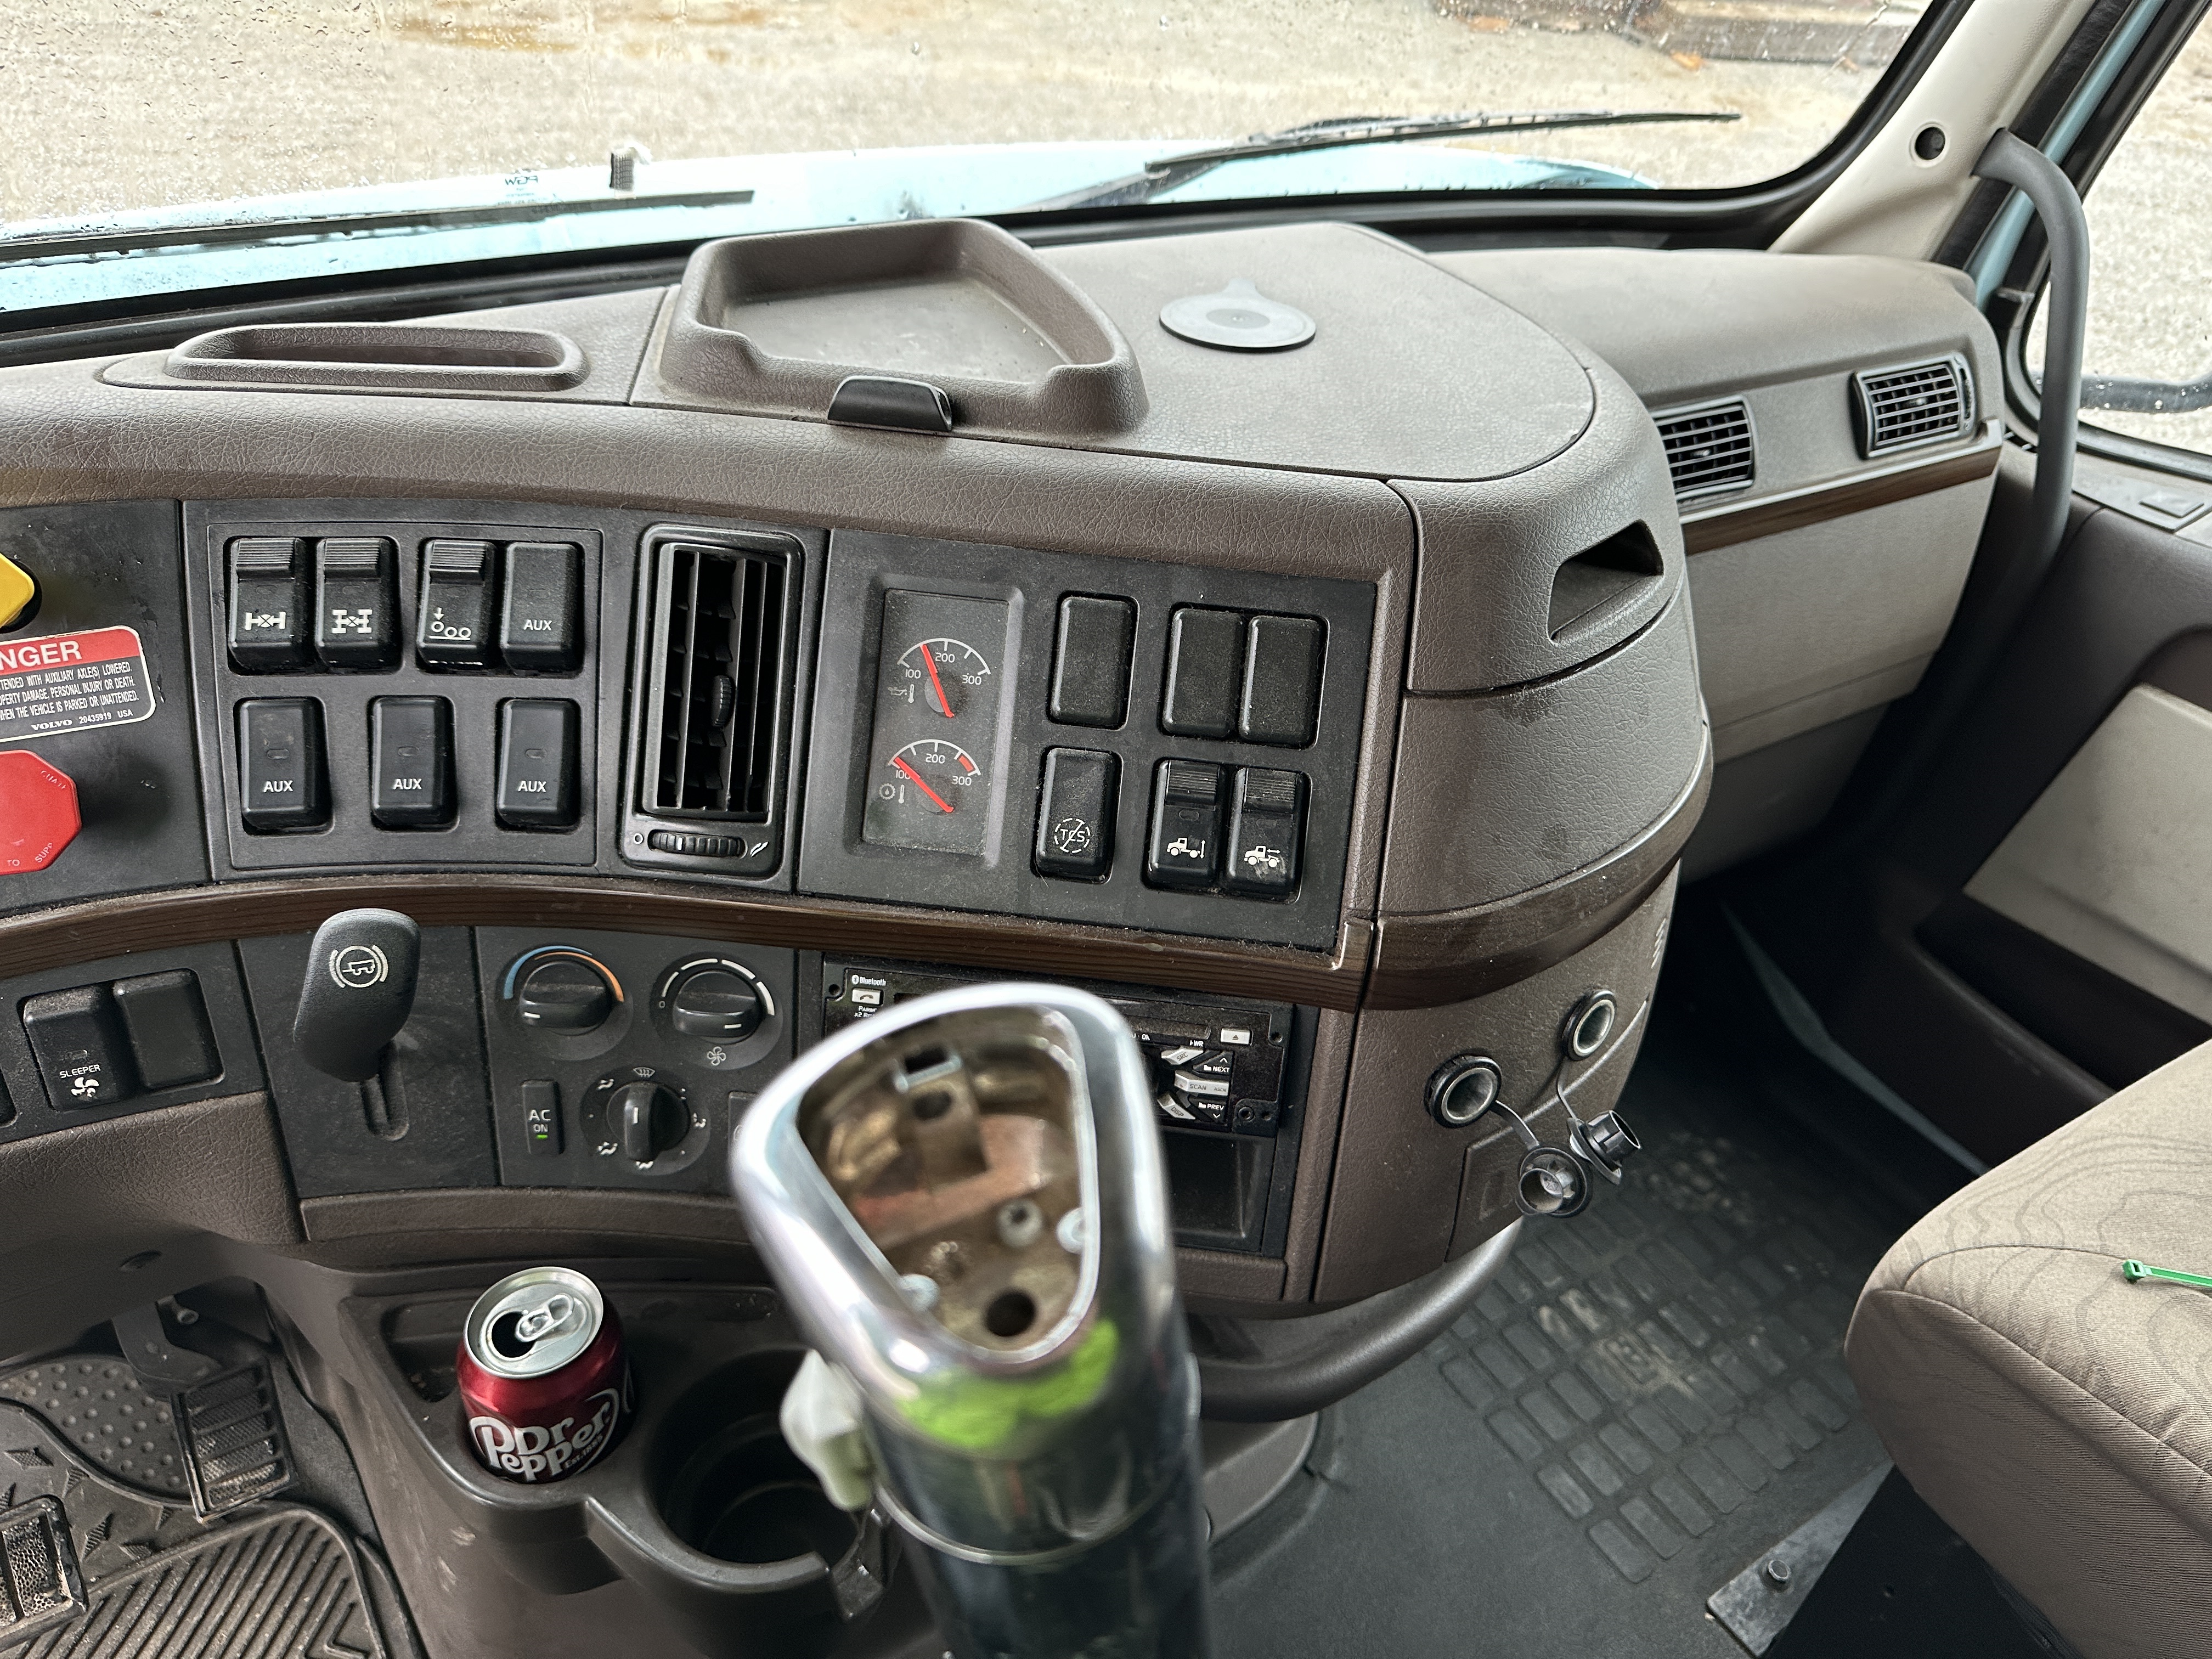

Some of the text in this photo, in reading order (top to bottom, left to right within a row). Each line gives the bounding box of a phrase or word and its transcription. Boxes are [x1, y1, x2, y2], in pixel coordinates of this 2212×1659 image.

[523, 619, 552, 631] AUX
[0, 640, 82, 670] NGER
[935, 652, 955, 663] 200
[0, 661, 133, 690] TENDED WITH AUXILIARY AXLE(S) LOWERED.
[905, 669, 921, 679] 100
[962, 674, 982, 686] 300
[21, 688, 50, 702] DAMAGE,
[49, 684, 82, 698] PERSONAL
[82, 680, 103, 693] INJURY
[104, 679, 115, 690] OR
[114, 675, 136, 689] DEATH.
[15, 706, 29, 718] THE
[29, 702, 55, 716] VEHICLE
[55, 701, 63, 712] IS
[64, 697, 88, 712] PARKED
[89, 696, 99, 707] OR
[99, 690, 139, 706] UNATTENDED.
[31, 709, 134, 731] VOLVO 20435919 USA
[926, 753, 946, 764] 200
[895, 769, 911, 780] 100
[952, 775, 972, 786] 300
[263, 780, 293, 793] AUX
[392, 778, 422, 791] AUX
[517, 780, 547, 793] AUX
[1060, 828, 1085, 843] TCS
[860, 977, 886, 986] Bluetooth
[1176, 1052, 1188, 1061] SRC
[59, 1064, 101, 1079] SLEEPER
[529, 1109, 551, 1121] AC
[1171, 1106, 1184, 1116] DISP
[533, 1124, 548, 1133] ON
[470, 1401, 611, 1481] Pepper
[514, 1417, 575, 1456] Dr
